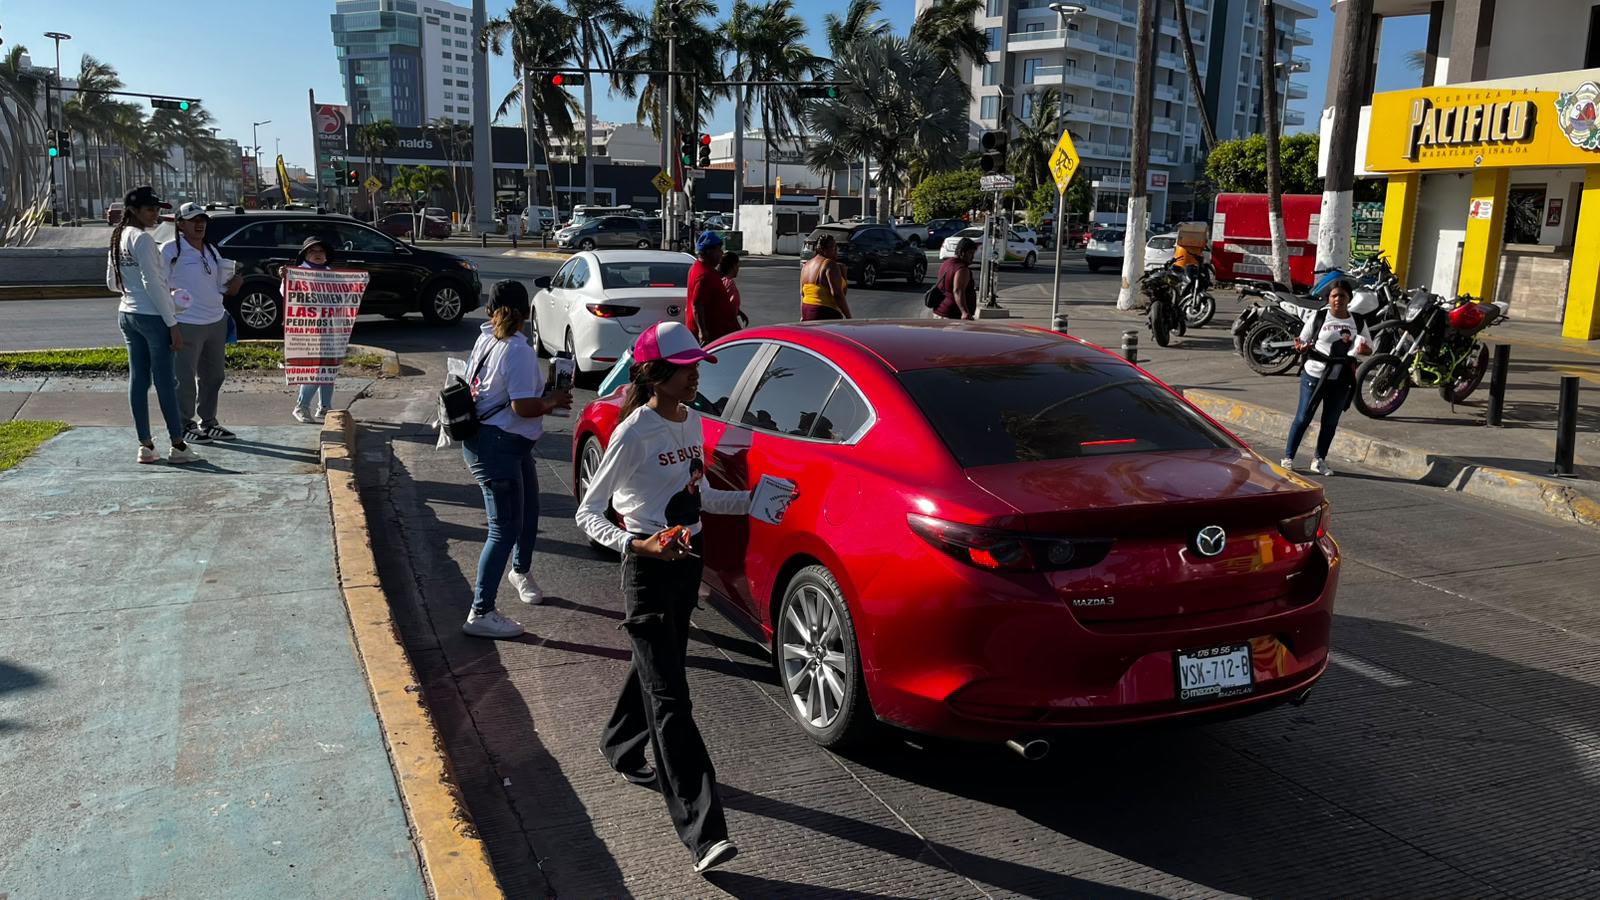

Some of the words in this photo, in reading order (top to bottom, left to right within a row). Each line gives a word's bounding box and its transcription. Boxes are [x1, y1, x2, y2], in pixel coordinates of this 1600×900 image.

[1436, 92, 1501, 103] CERVEZA
[1511, 87, 1540, 96] DEL
[1402, 97, 1530, 159] PACIFICO
[288, 280, 309, 291] LAS
[288, 292, 342, 303] PRESUMEN
[287, 306, 317, 318] LAS
[287, 318, 328, 327] PEDIMOS
[658, 451, 677, 467] SE
[676, 445, 702, 462] BUS
[1181, 655, 1249, 687] VSK-712-B
